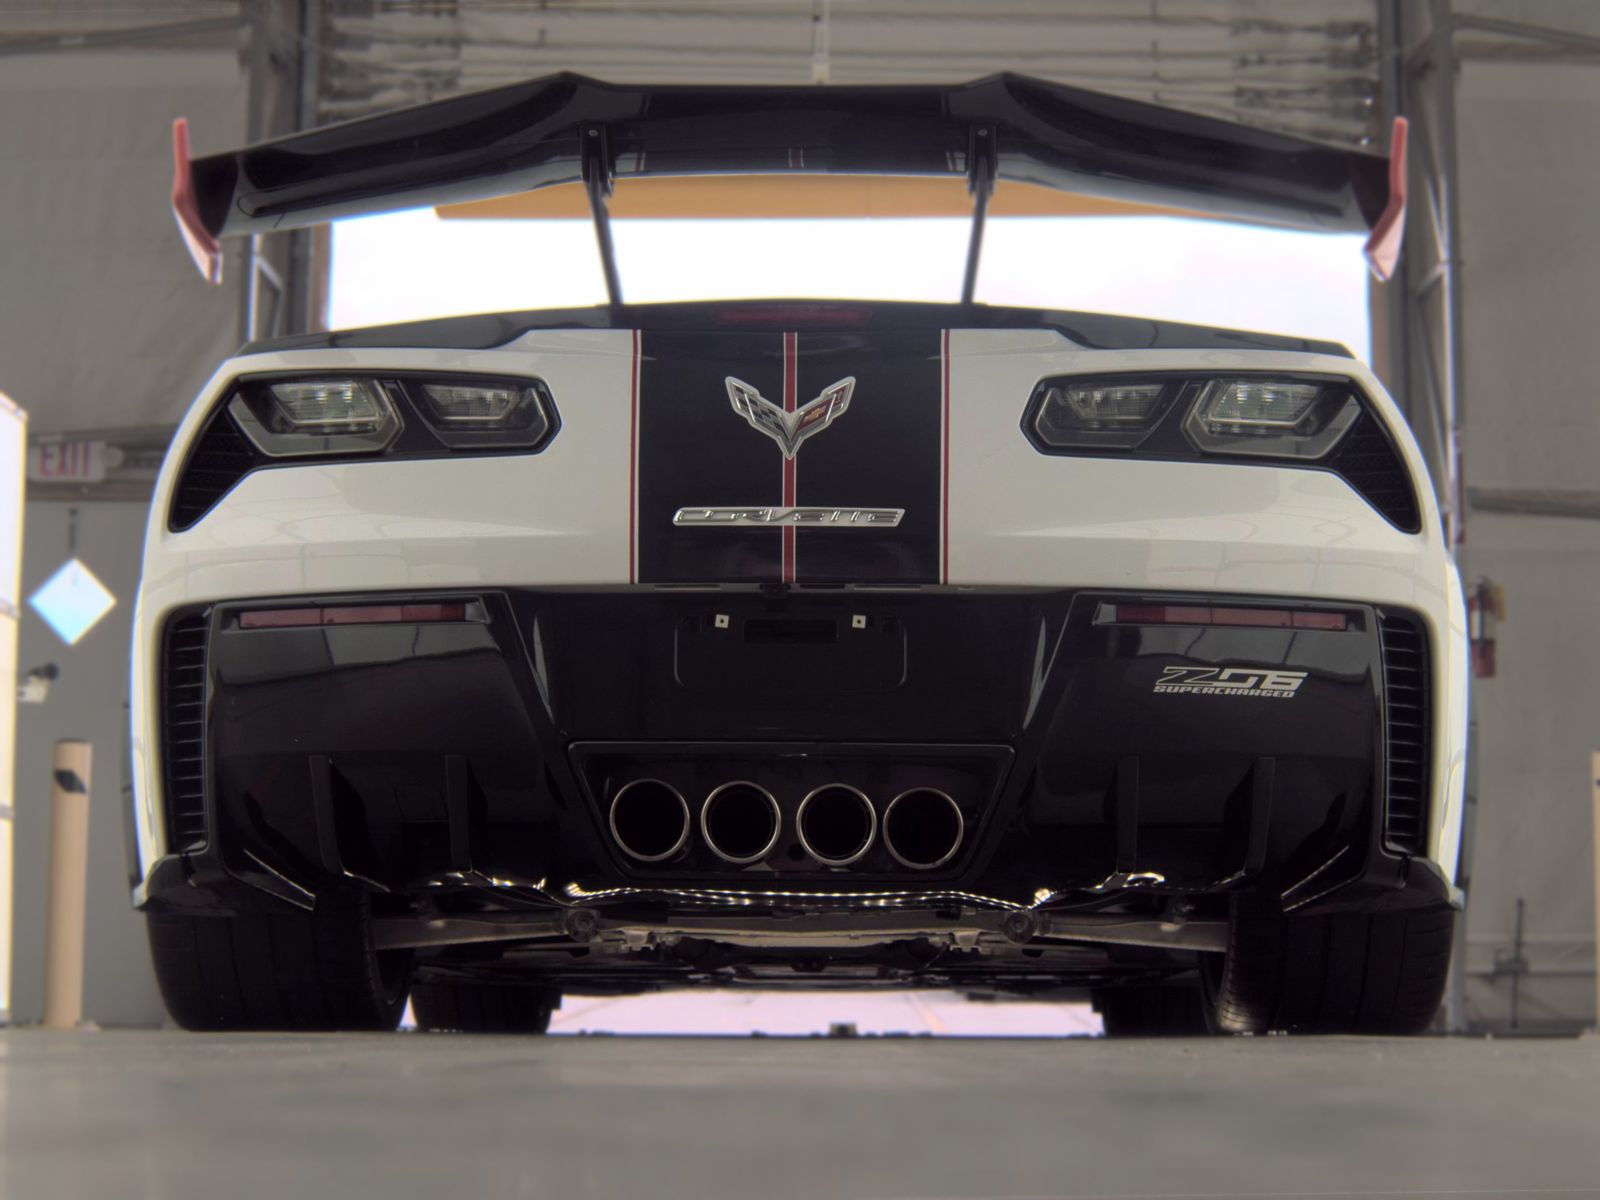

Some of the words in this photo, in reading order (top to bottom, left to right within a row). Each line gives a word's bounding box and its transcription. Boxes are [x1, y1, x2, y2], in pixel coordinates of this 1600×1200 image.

[40, 441, 92, 477] EXIT
[1155, 666, 1308, 690] Z06
[1153, 685, 1295, 698] SUPERCHARGED
